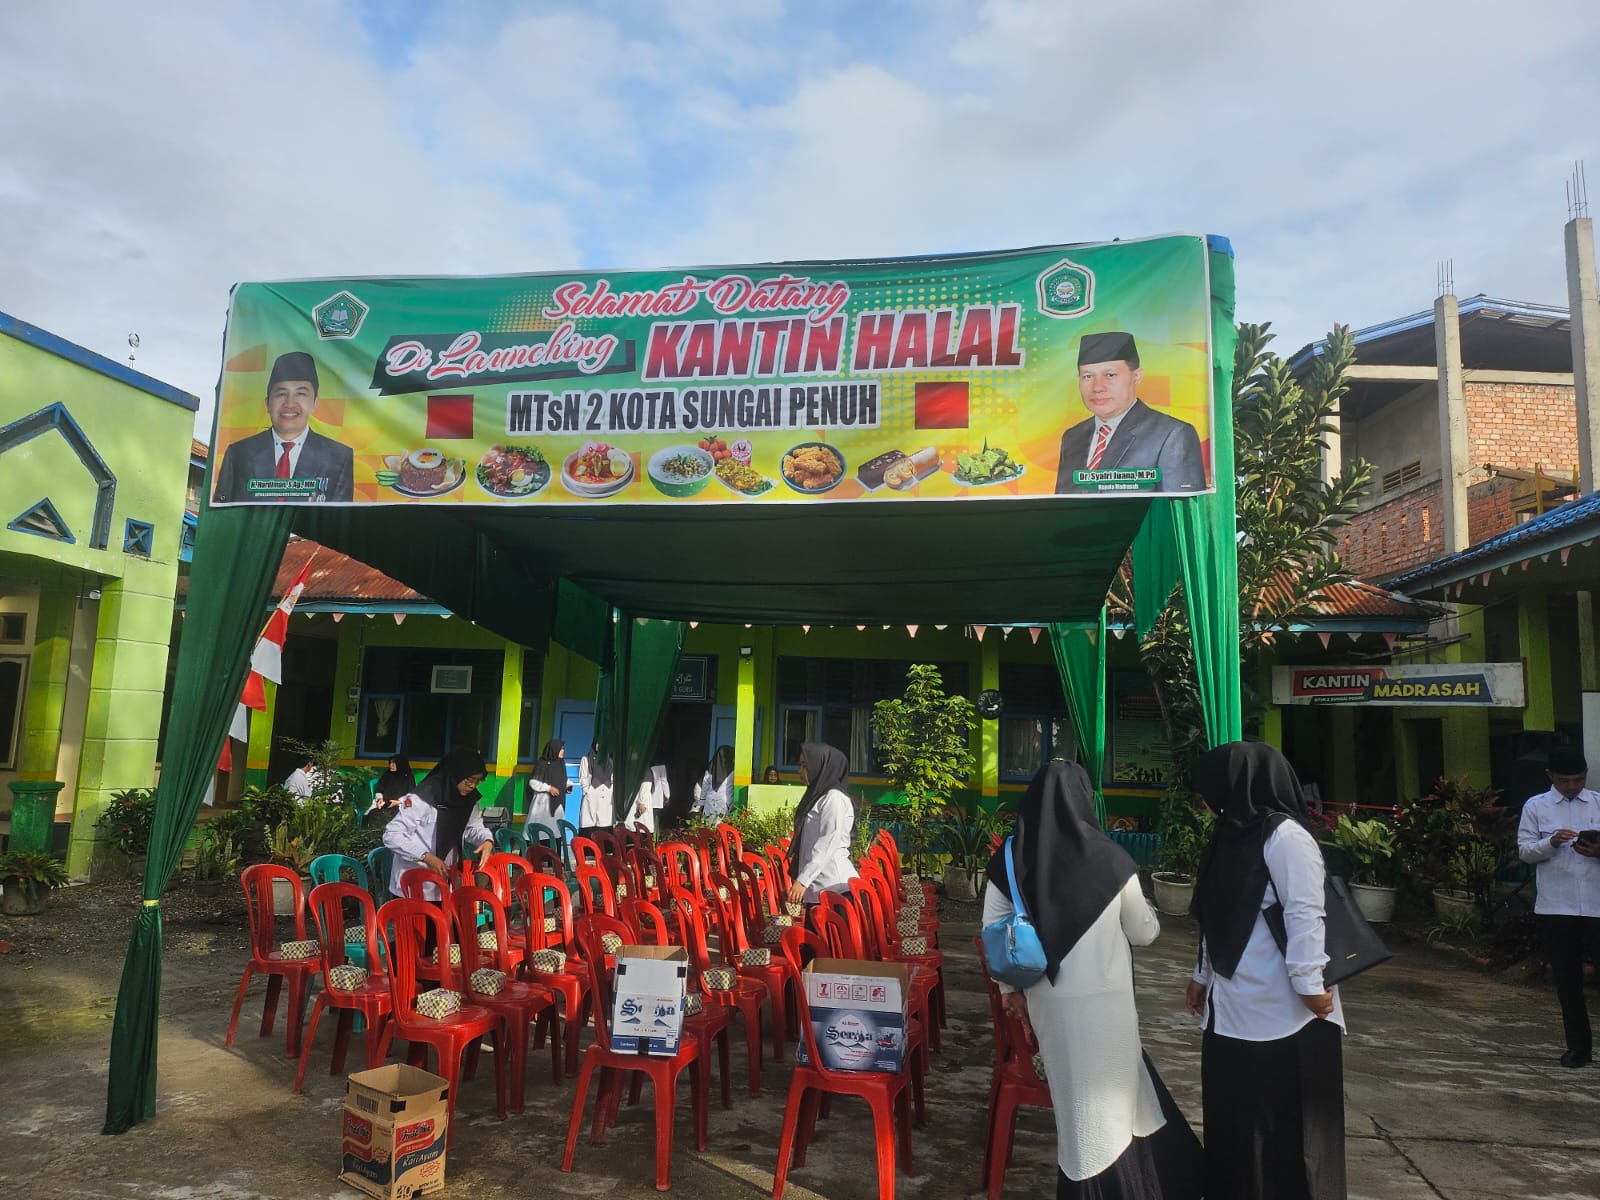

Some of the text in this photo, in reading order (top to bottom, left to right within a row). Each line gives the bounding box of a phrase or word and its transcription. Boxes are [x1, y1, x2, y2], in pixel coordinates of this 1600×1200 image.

[543, 274, 850, 325] Selamat Datang
[386, 322, 619, 379] Di Launching
[644, 306, 1023, 380] KANTIN HALAL
[509, 384, 877, 432] MTsN 2 KOTA SUNGAI PENUH
[1079, 471, 1090, 480] Dr.
[1303, 674, 1480, 697] KANTIN MADRASAH
